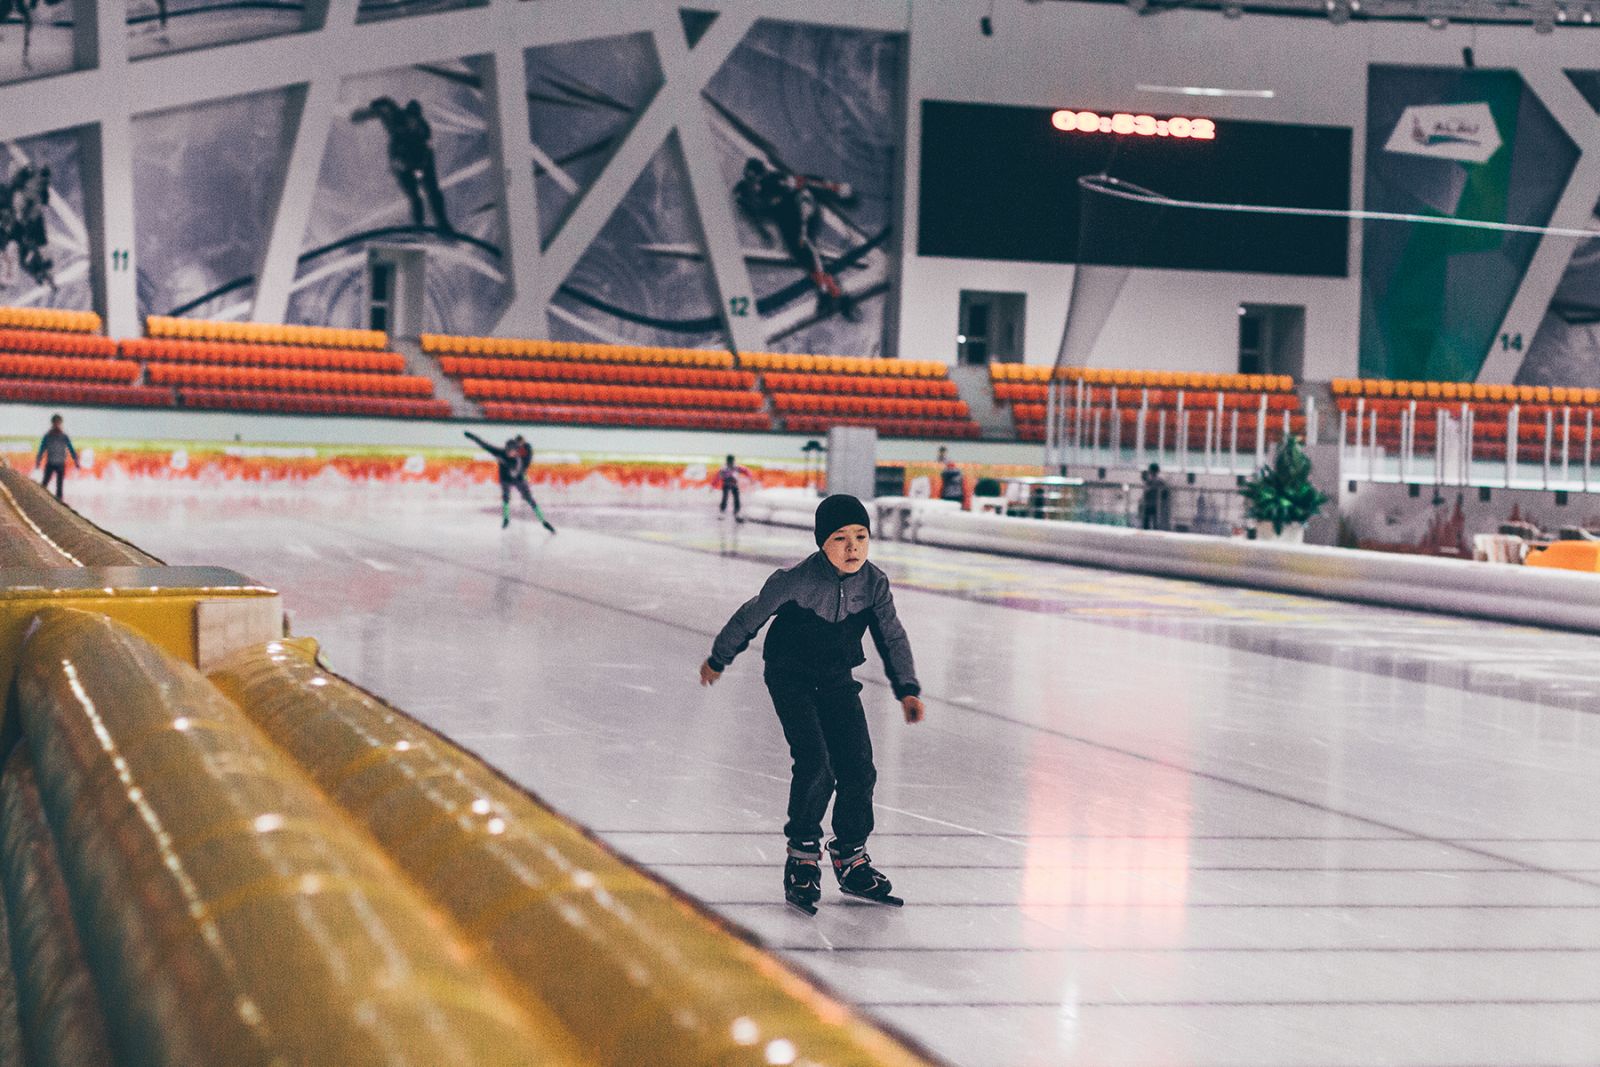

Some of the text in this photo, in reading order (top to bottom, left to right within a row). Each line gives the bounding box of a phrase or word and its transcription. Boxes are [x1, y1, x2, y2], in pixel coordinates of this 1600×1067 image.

[112, 248, 129, 271] 11
[729, 296, 750, 317] 12
[1501, 332, 1522, 351] 14
